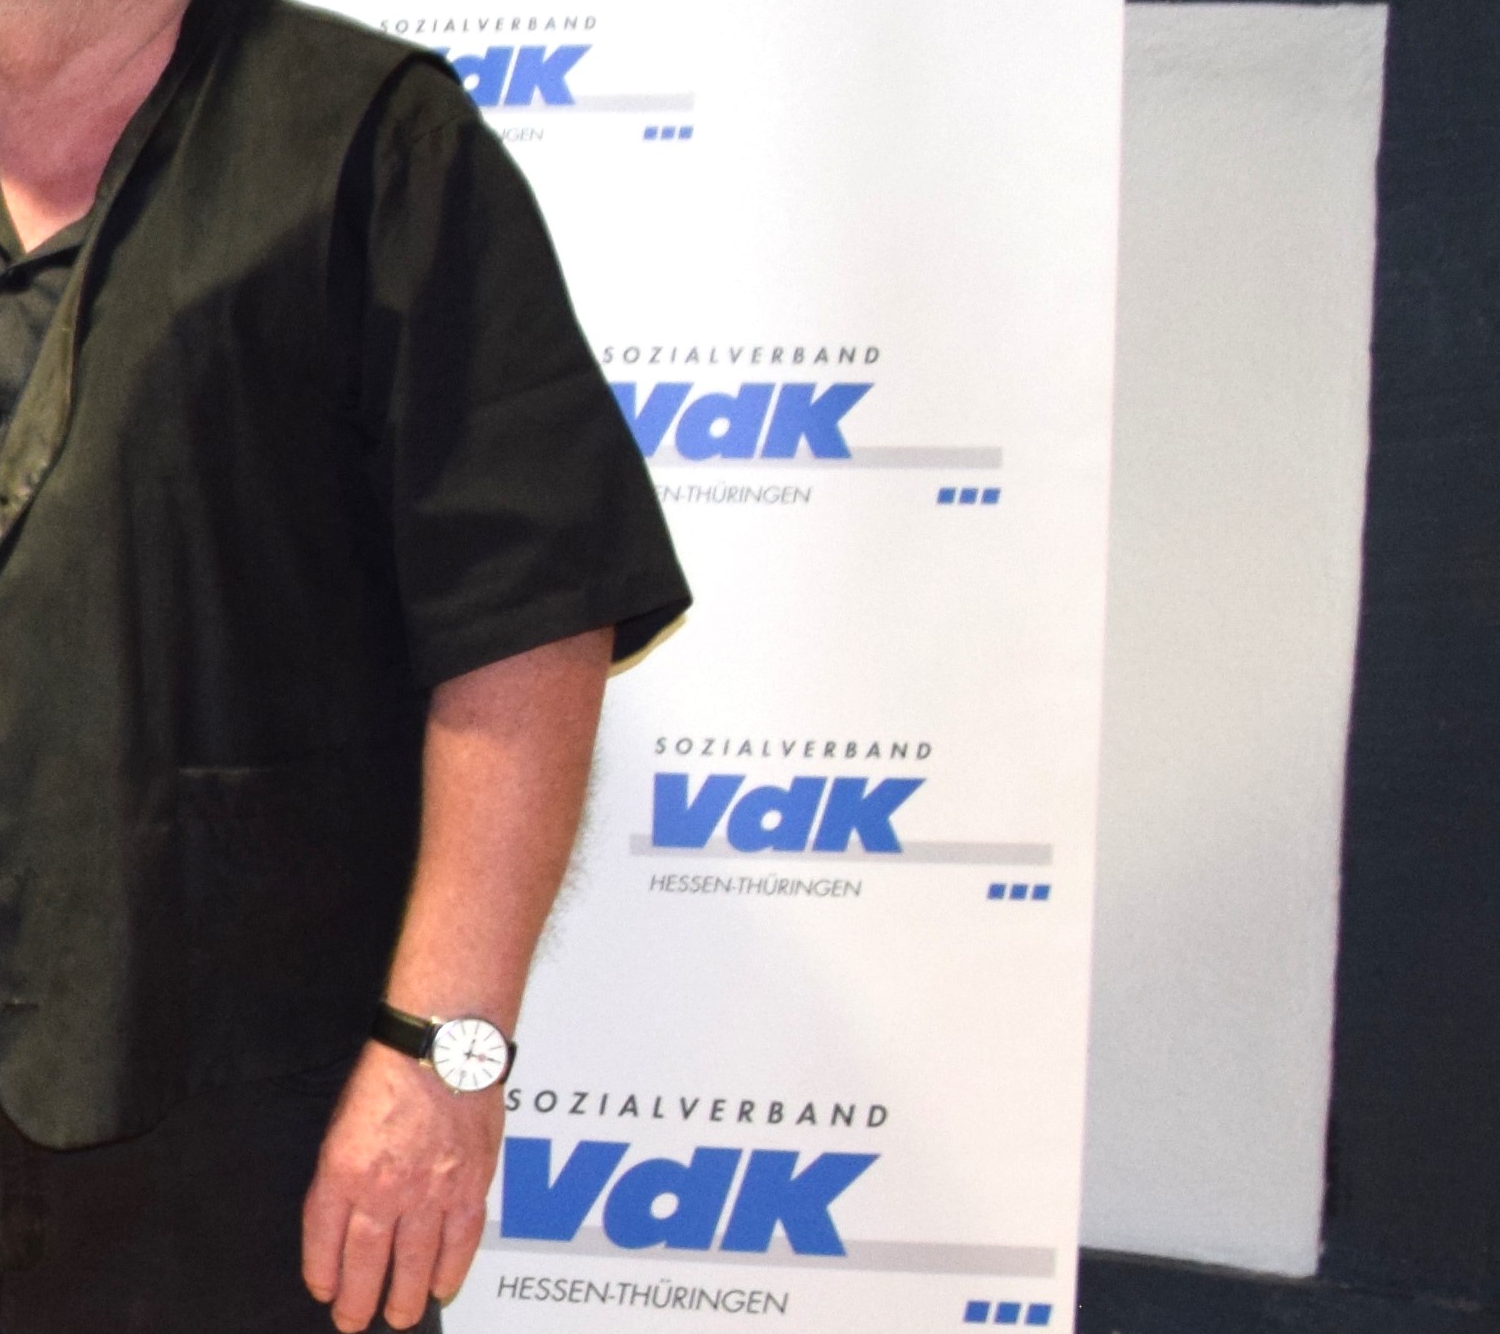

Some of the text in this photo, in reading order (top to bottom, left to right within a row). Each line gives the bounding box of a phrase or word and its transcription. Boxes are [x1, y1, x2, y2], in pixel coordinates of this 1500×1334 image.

[380, 16, 597, 34] SOZIALVERBAND
[436, 44, 592, 106] dK
[603, 345, 881, 366] SOZIALVERBAND
[610, 381, 874, 461] VdK
[656, 479, 813, 505] EN-THÜRINGEN
[655, 737, 932, 761] SOZIALVERBAND
[652, 772, 925, 853] VdK
[648, 873, 862, 897] HESSEN-THÜRINGEN
[504, 1088, 888, 1129] SOZIALVERBAND
[500, 1135, 878, 1257] VdK
[497, 1275, 789, 1315] HESSEN-THÜRINGEN
